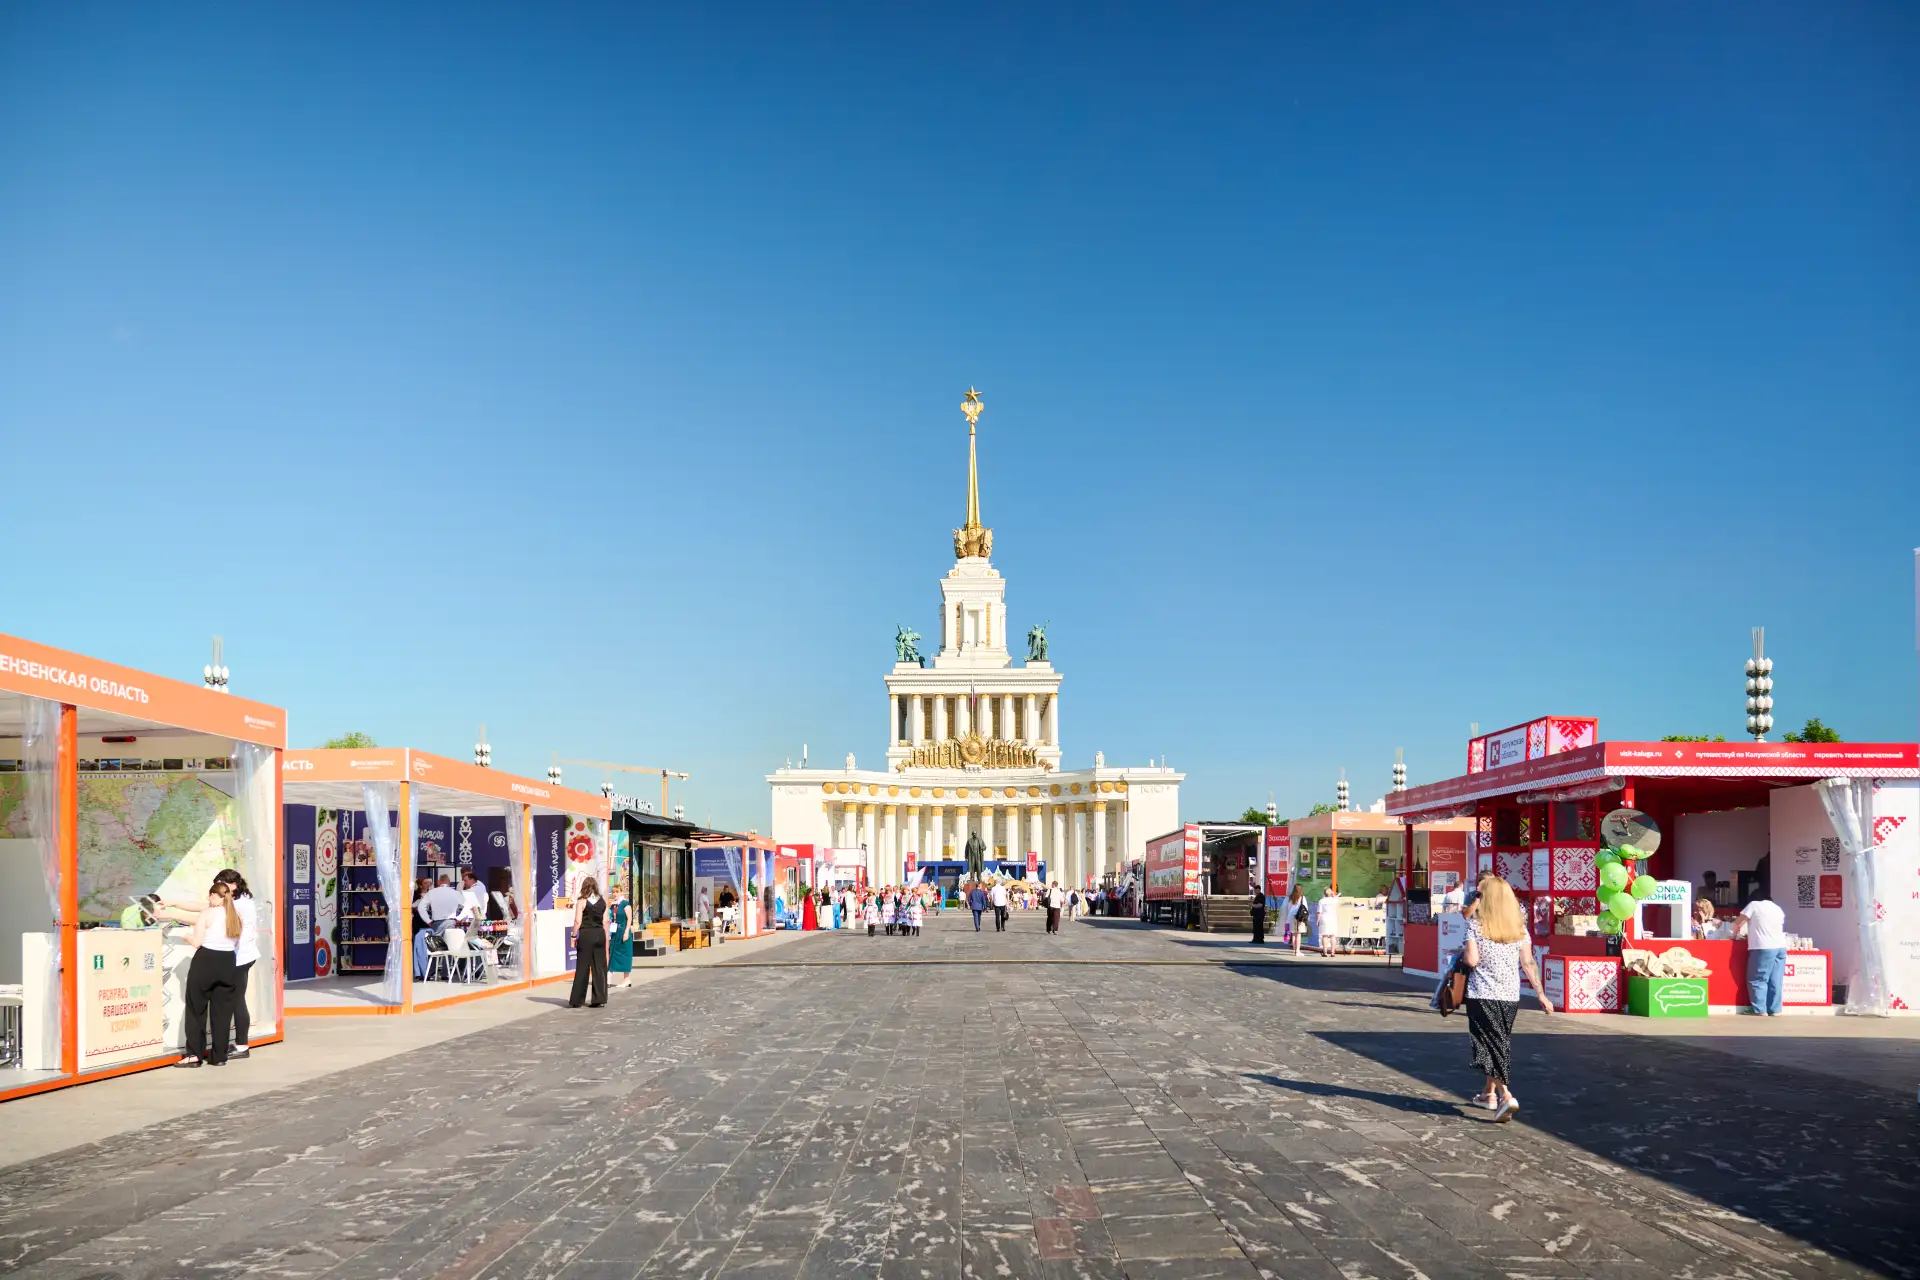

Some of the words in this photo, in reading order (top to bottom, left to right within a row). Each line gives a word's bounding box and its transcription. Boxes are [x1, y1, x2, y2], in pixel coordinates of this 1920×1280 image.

[90, 677, 150, 704] ОБЛАСТЬ
[1695, 751, 1736, 759] путешествуй
[1745, 751, 1780, 759] Калужской
[282, 760, 314, 771] АСТЬ
[418, 828, 445, 841] ИРОВСКАЯ
[1656, 885, 1687, 893] ONIVA
[1641, 893, 1683, 901] КОНИВА
